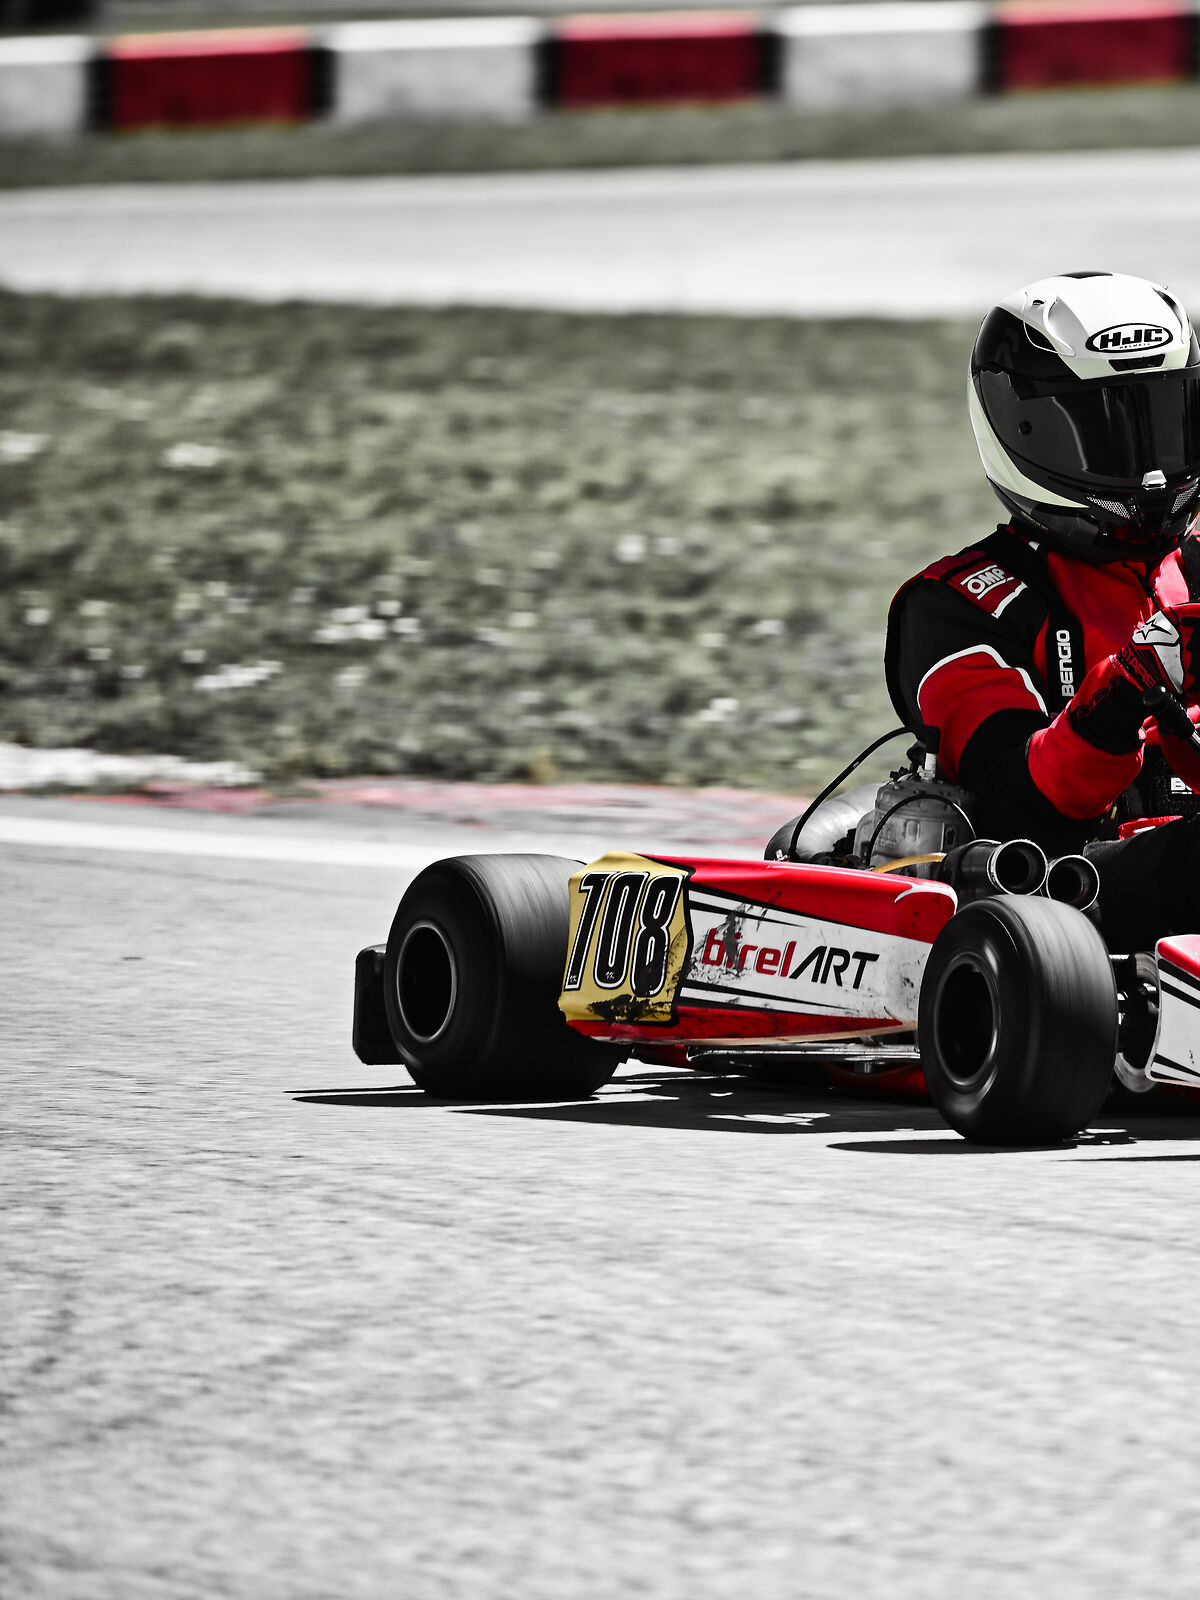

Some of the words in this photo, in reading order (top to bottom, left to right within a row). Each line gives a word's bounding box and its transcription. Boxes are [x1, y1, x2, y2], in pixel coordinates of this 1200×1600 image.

[1100, 329, 1162, 349] HJC
[967, 568, 1006, 594] OMP
[1056, 630, 1074, 696] BENGIO
[564, 871, 685, 997] 108
